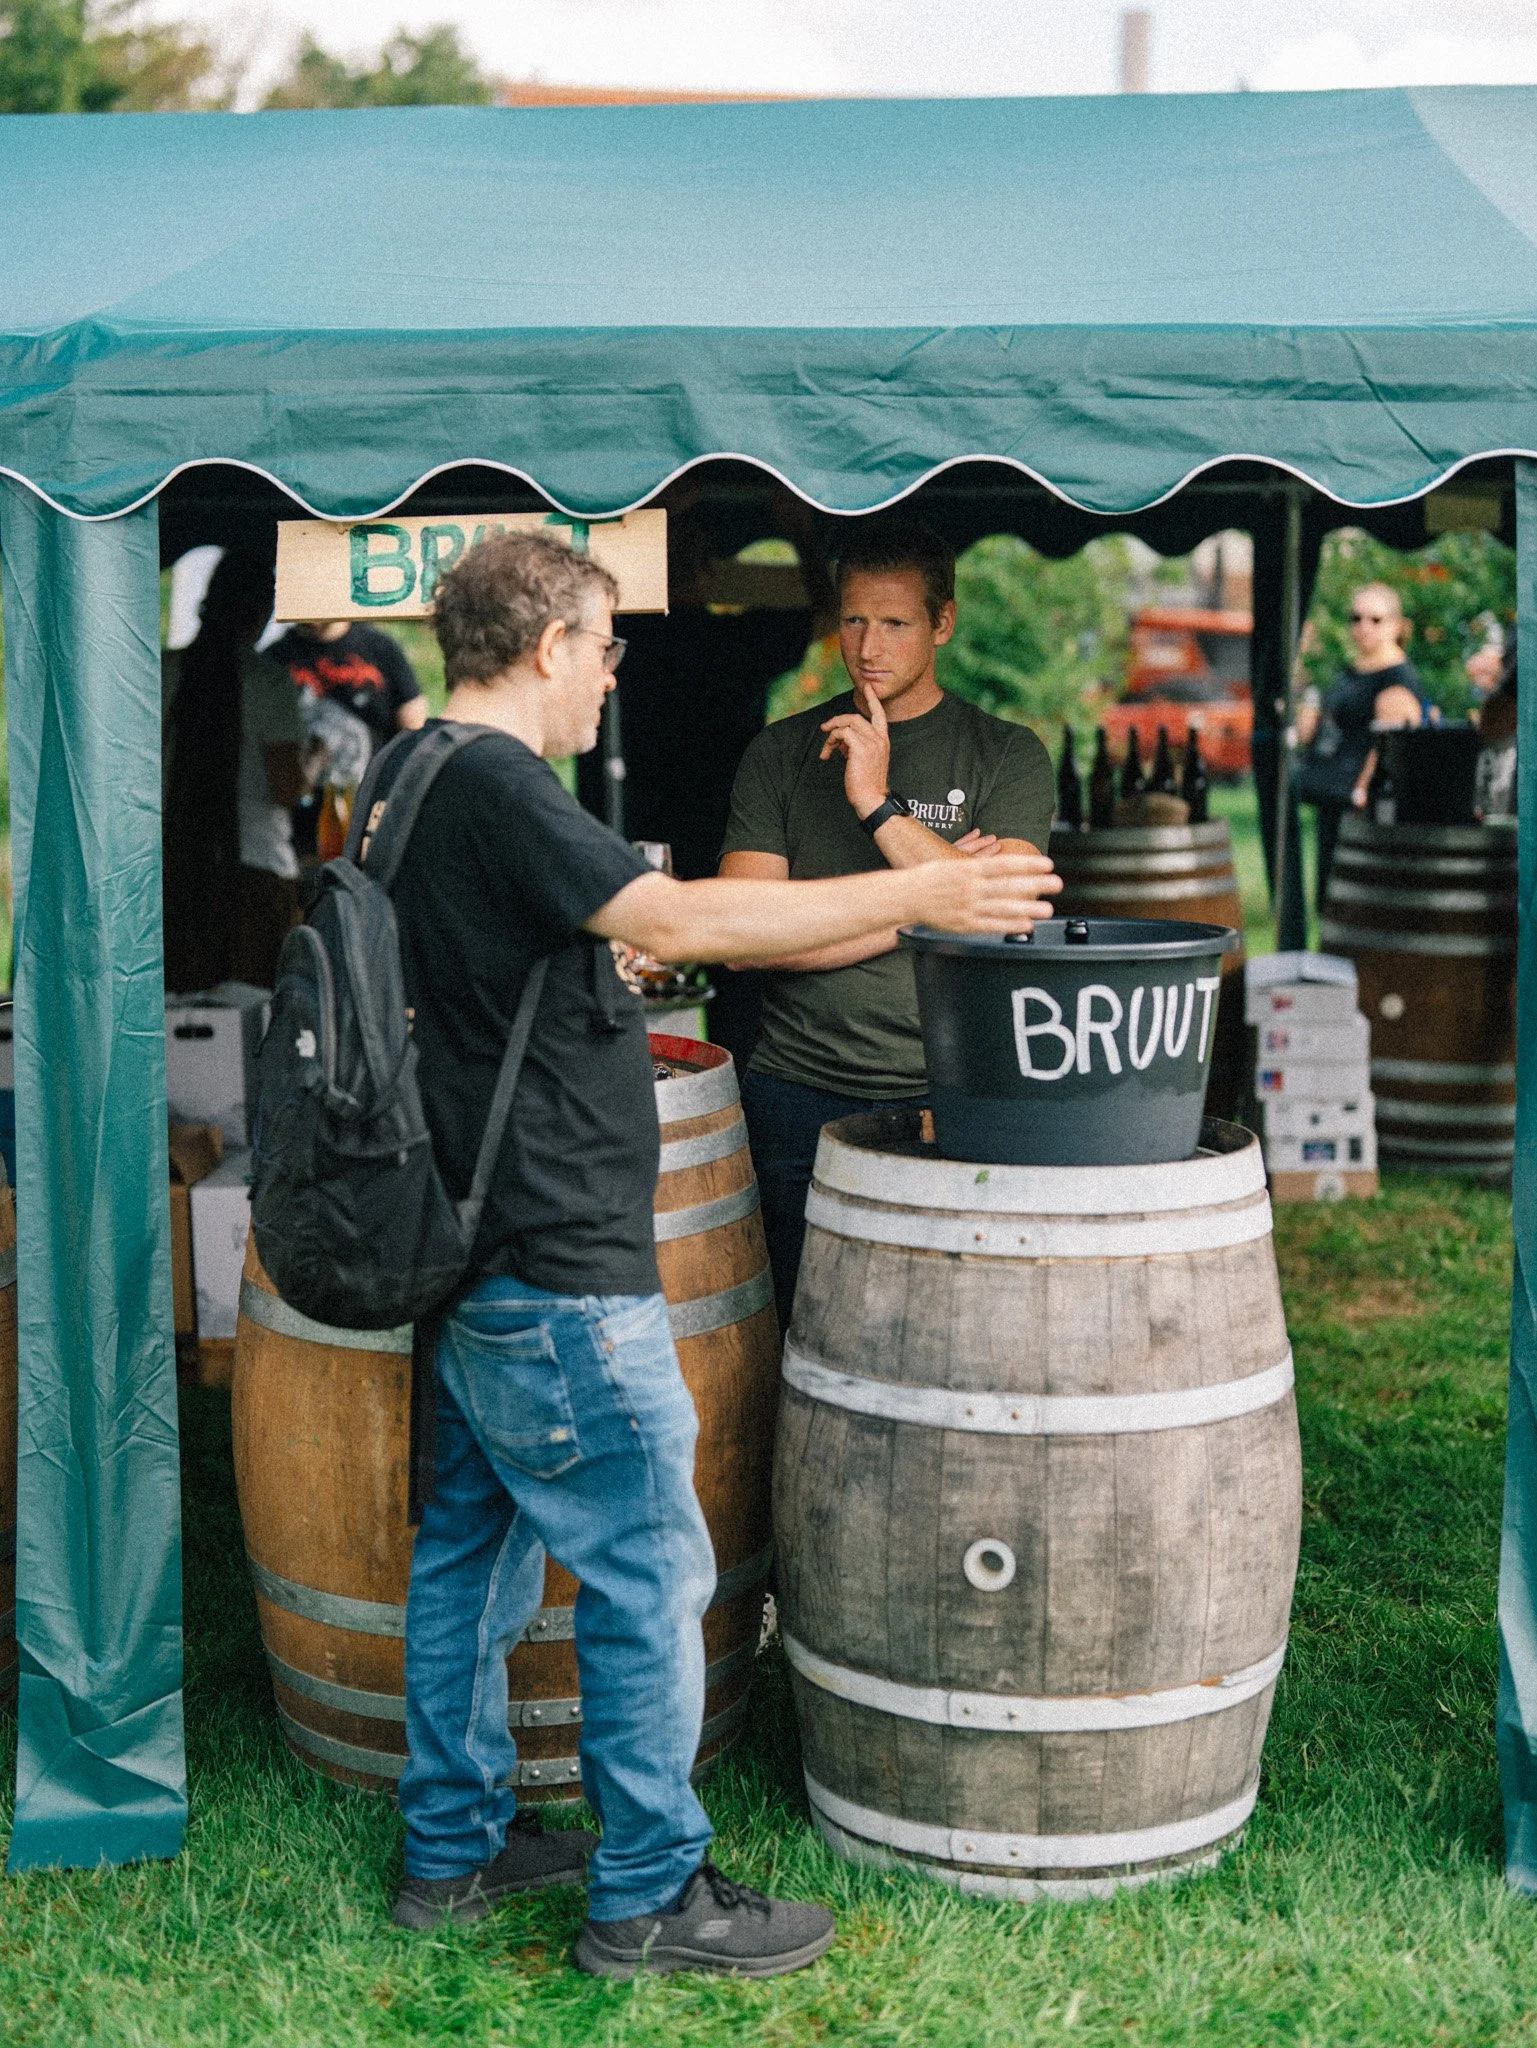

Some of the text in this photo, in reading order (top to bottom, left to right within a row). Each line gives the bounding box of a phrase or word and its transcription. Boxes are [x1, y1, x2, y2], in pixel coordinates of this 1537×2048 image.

[350, 511, 623, 607] BRT
[922, 821, 954, 830] INERY
[1011, 976, 1221, 1081] BRUUT
